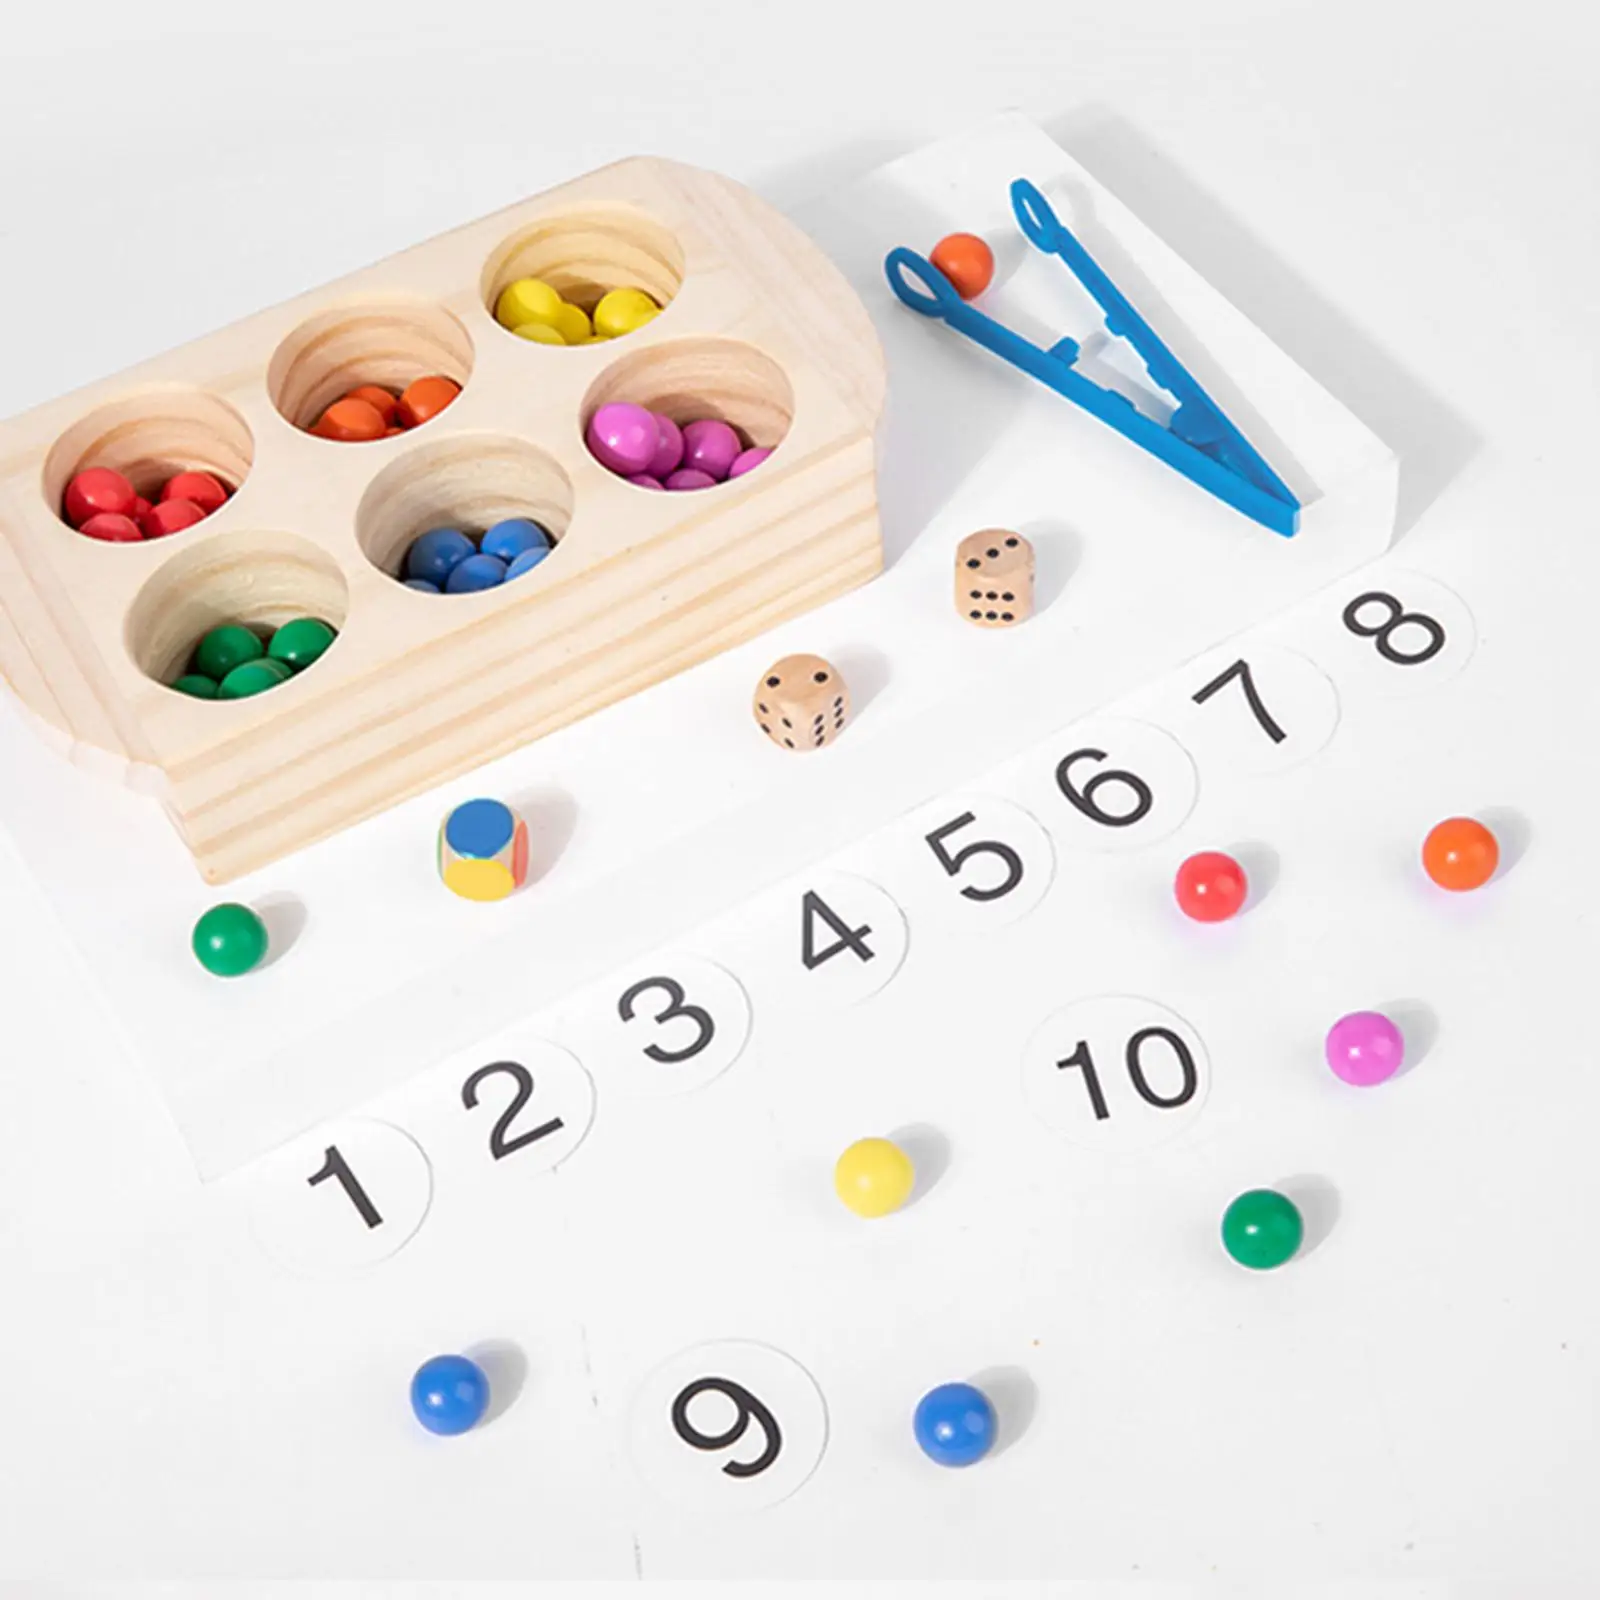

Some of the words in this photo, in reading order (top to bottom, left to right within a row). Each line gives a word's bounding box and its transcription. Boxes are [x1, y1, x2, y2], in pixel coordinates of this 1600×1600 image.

[1342, 591, 1446, 666] 8
[1191, 658, 1288, 745] 7
[1055, 748, 1154, 828] 6
[924, 810, 1024, 903] 5
[799, 889, 876, 971] 4
[617, 976, 715, 1064] 3
[461, 1060, 565, 1161] 2
[1056, 1026, 1199, 1121] 10
[306, 1145, 384, 1230] 1
[671, 1376, 783, 1479] 9
